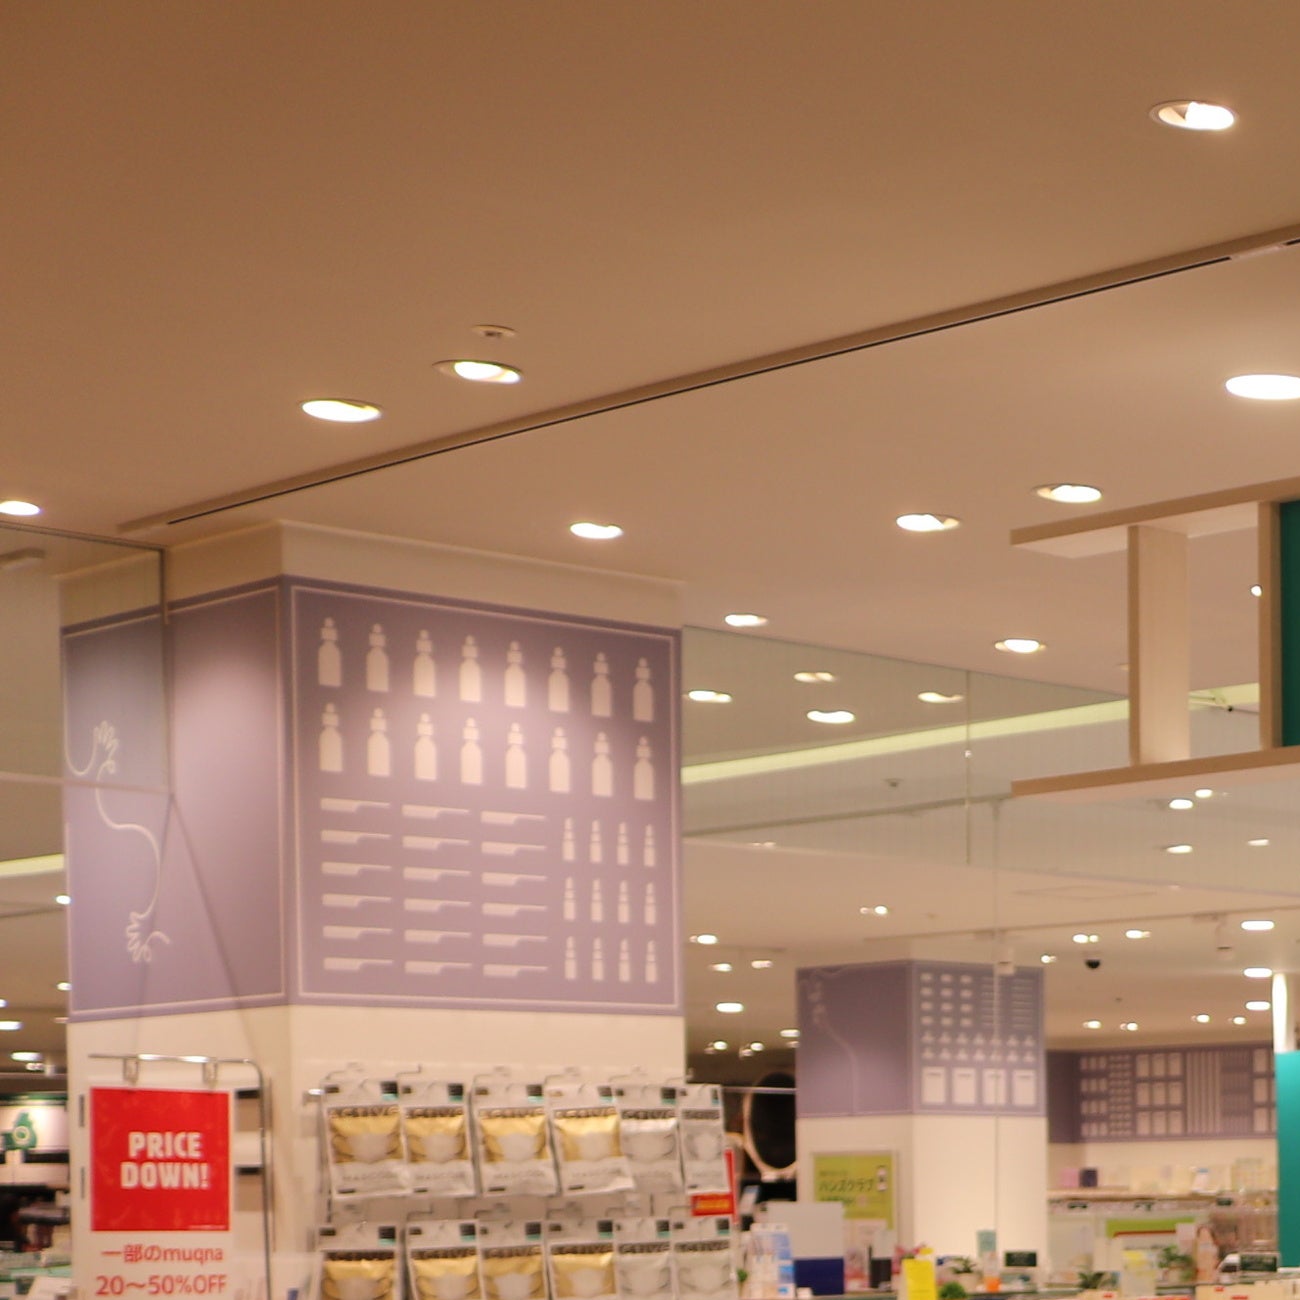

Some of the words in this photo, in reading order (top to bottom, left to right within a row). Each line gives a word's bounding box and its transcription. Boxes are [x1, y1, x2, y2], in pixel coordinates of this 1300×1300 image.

[128, 1131, 203, 1159] PRICE
[119, 1161, 211, 1190] DOWN!
[102, 1243, 225, 1265] 一部のmuqna
